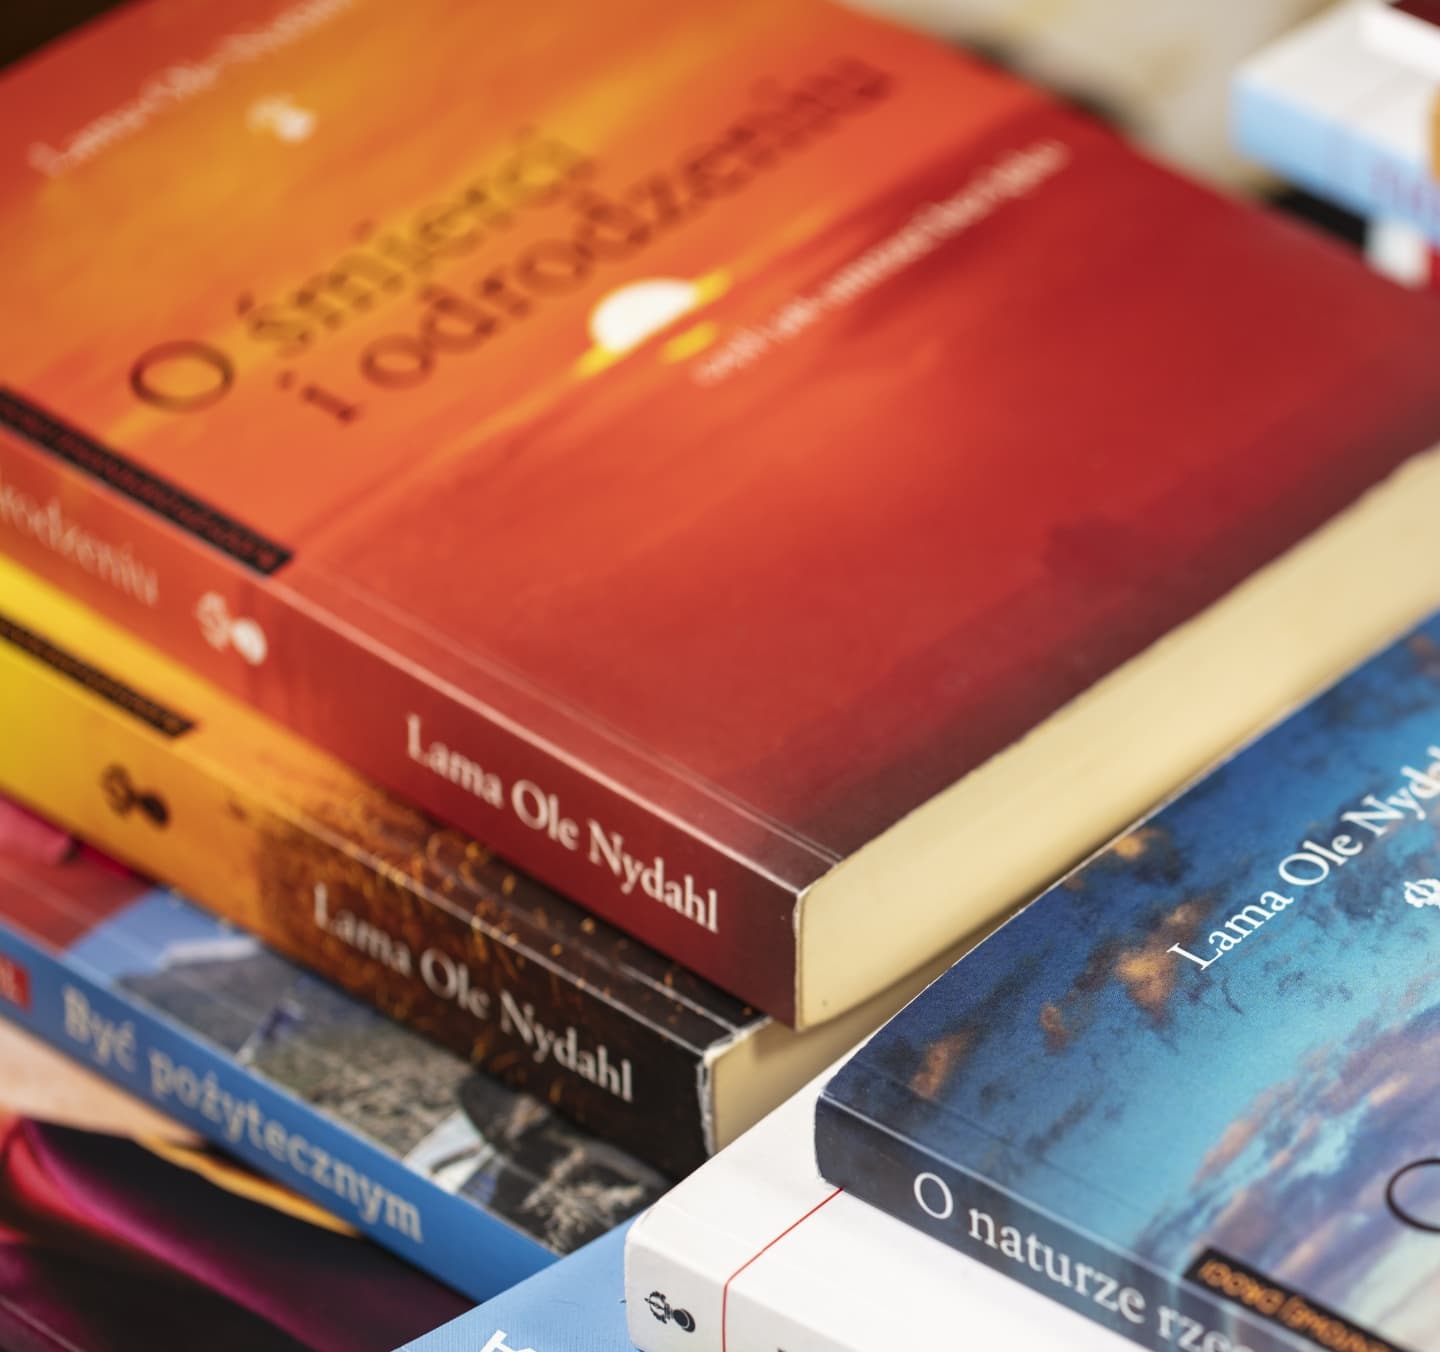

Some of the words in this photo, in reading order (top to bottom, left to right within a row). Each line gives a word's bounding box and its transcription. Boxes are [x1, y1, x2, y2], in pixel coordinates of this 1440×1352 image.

[276, 370, 358, 422] i
[358, 55, 895, 391] odrodzeniu
[131, 340, 235, 412] O
[407, 713, 504, 809] Lama
[511, 779, 580, 851] Ole
[588, 818, 719, 934] Nydahl
[1167, 890, 1294, 971] Lama
[1278, 834, 1363, 887] Ole
[314, 881, 412, 977] Lama
[420, 947, 492, 1019] Ole
[500, 988, 633, 1102] Nydahl
[62, 984, 137, 1073] Być
[149, 1048, 423, 1243] pożytecznym
[913, 1171, 954, 1220] O
[968, 1207, 1147, 1324] naturze
[1157, 1304, 1258, 1352] rze
